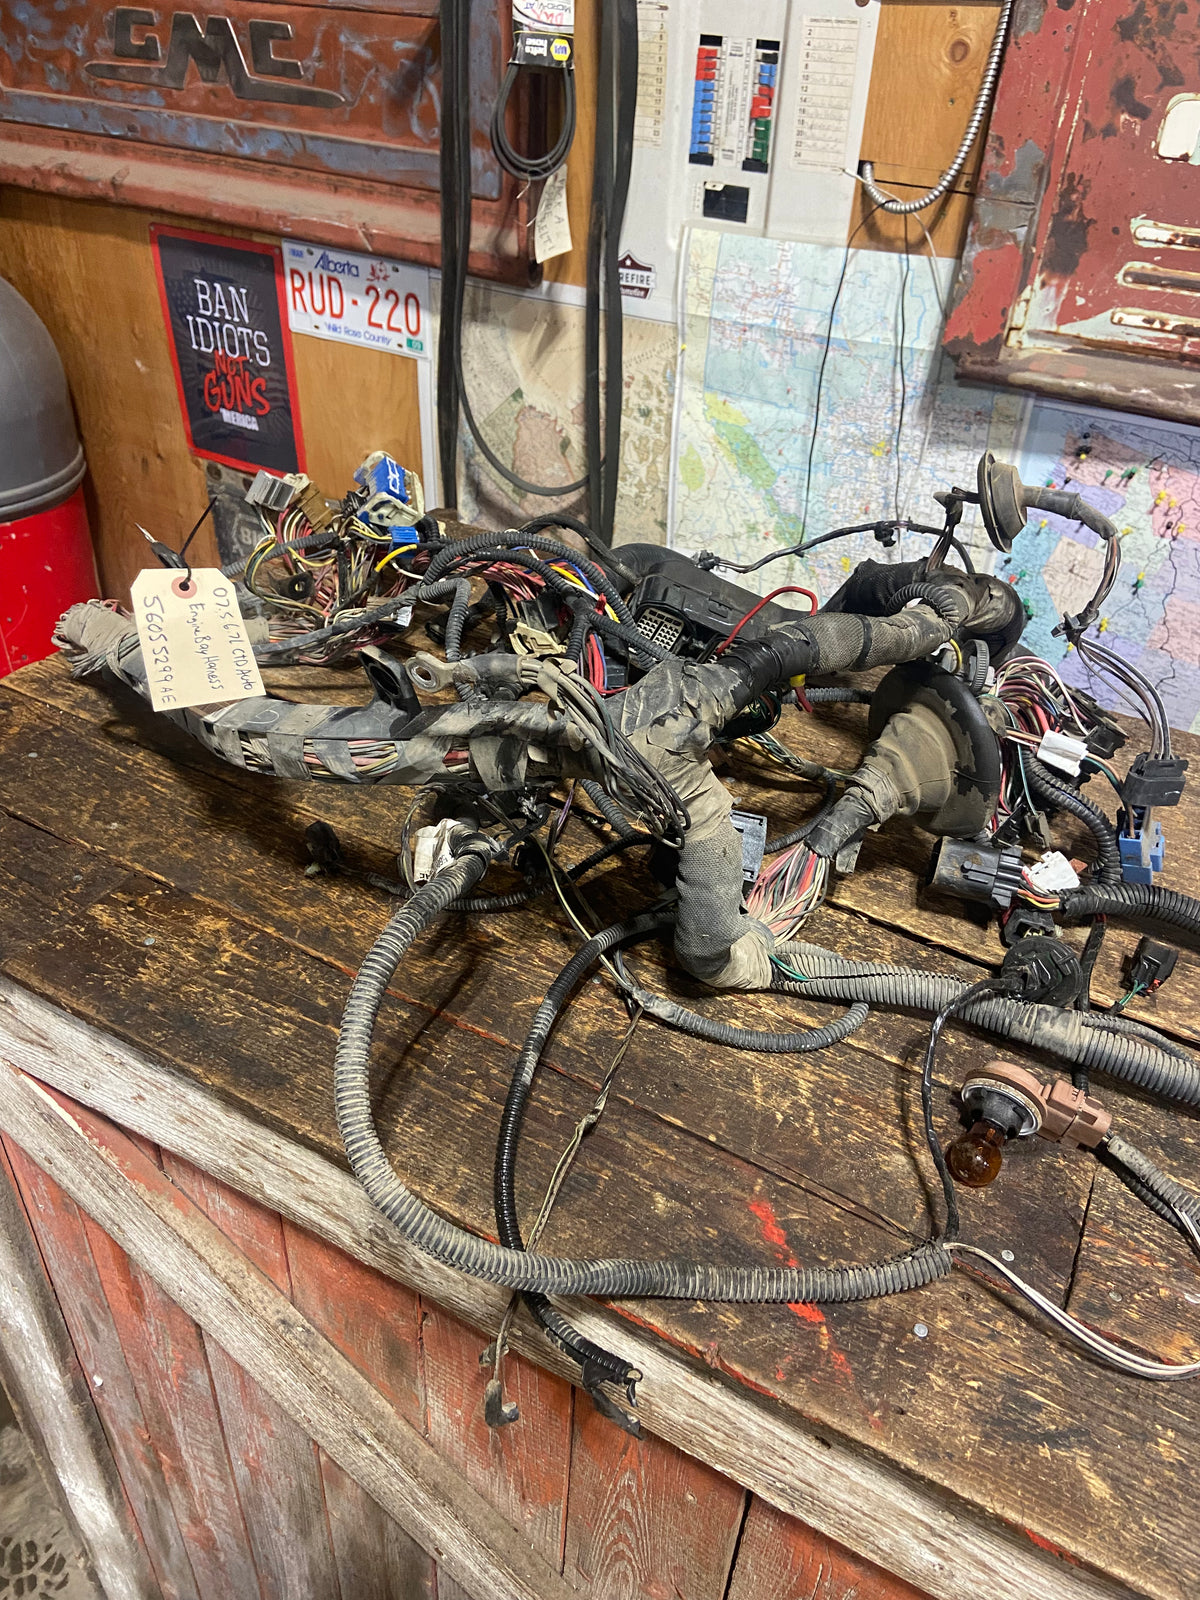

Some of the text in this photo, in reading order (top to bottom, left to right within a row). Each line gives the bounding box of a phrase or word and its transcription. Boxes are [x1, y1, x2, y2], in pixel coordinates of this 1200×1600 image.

[95, 6, 335, 107] GMC
[554, 216, 564, 224] A
[314, 251, 360, 278] Alberta
[194, 278, 250, 324] BAN
[186, 315, 271, 367] IDIOTS
[344, 328, 362, 338] Rose
[363, 331, 392, 346] Country
[214, 348, 248, 376] NOT
[204, 370, 271, 416] GUNS
[187, 602, 224, 690] Engine Bay Harness
[235, 668, 256, 691] Auto
